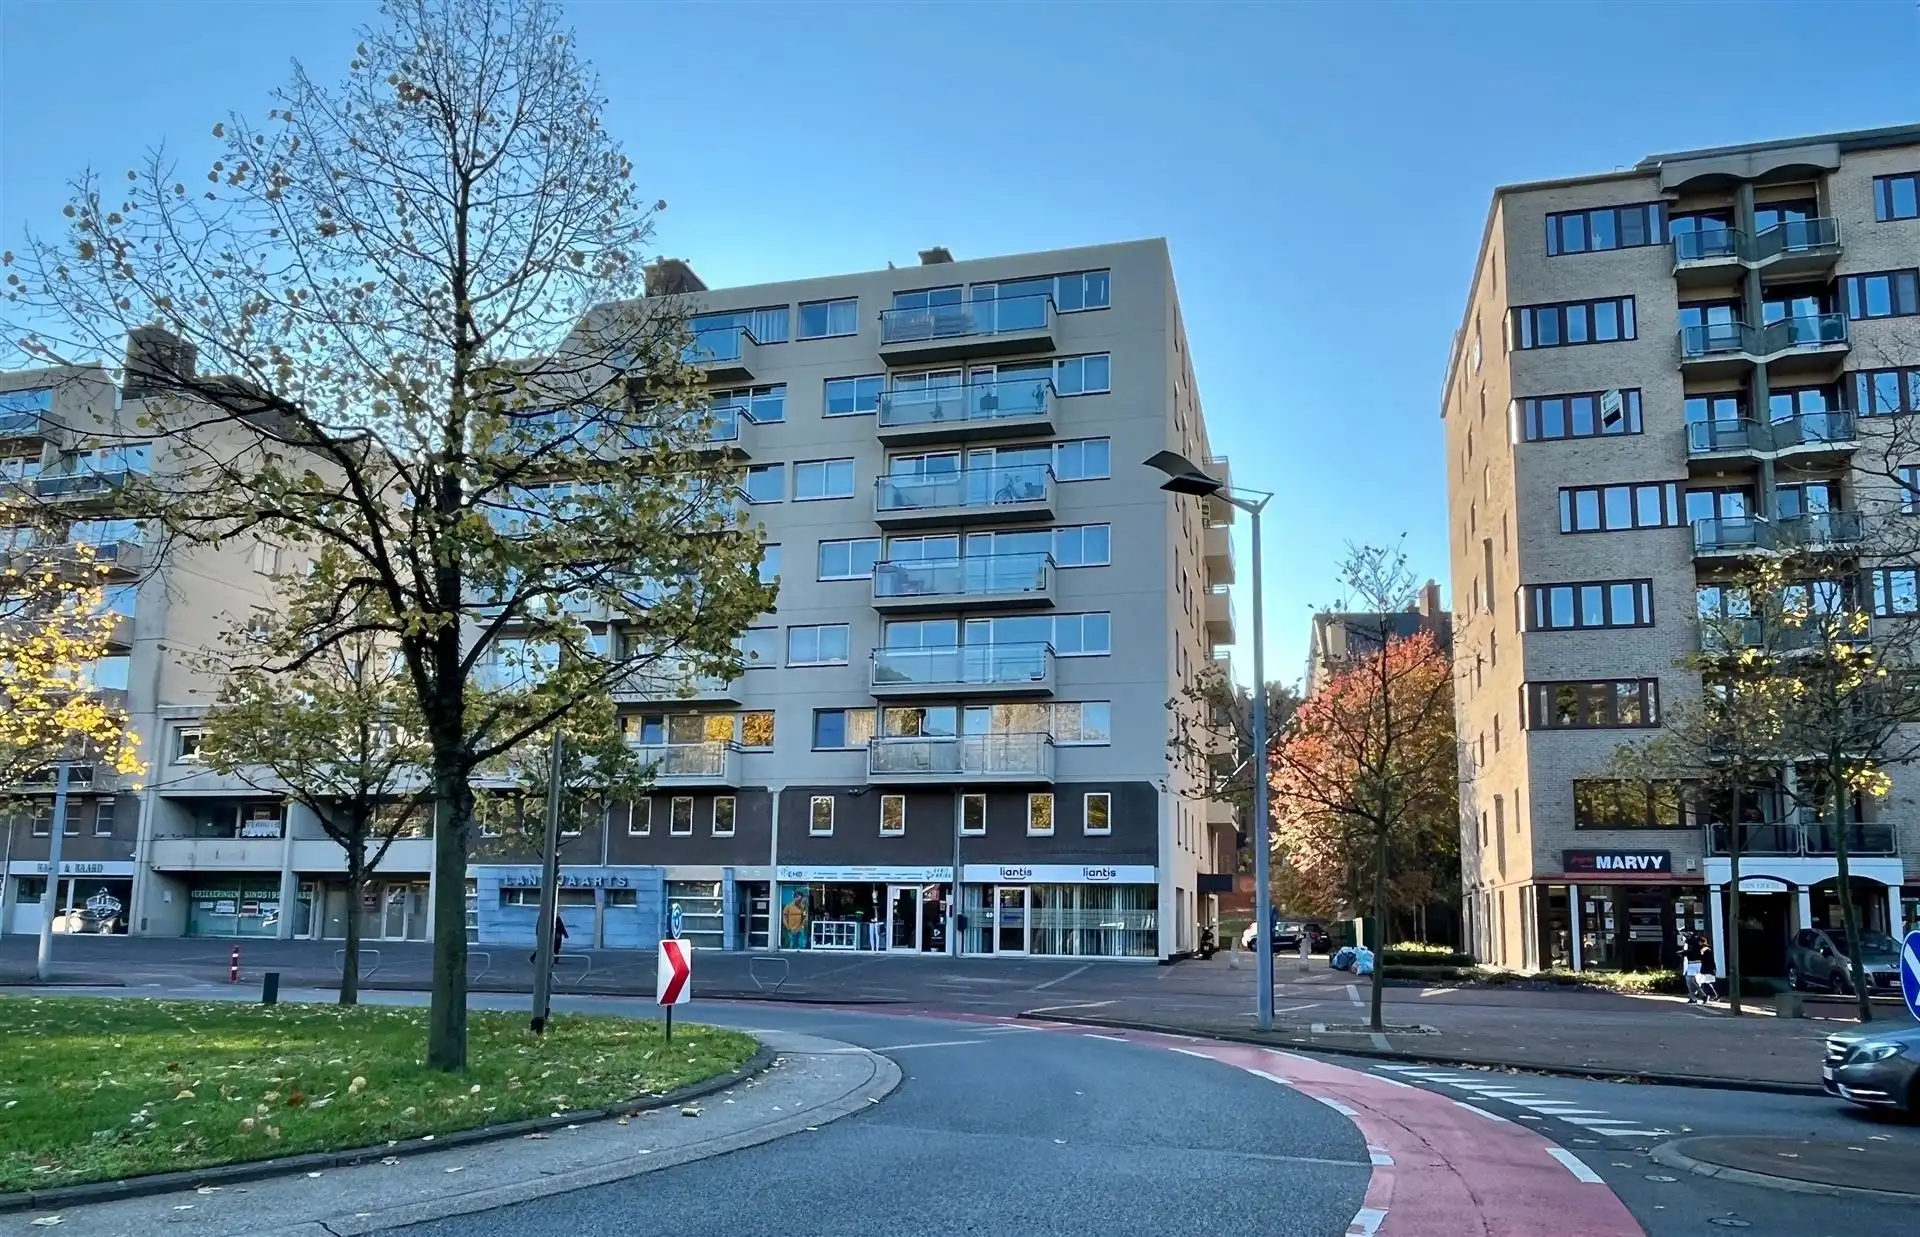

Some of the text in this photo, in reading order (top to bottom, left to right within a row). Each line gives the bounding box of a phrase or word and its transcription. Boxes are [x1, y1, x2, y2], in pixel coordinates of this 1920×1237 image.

[64, 863, 70, 873] &
[1596, 855, 1663, 869] MARVY
[1000, 866, 1032, 880] liantis
[1083, 866, 1117, 880] liantis
[244, 890, 267, 899] SINDS
